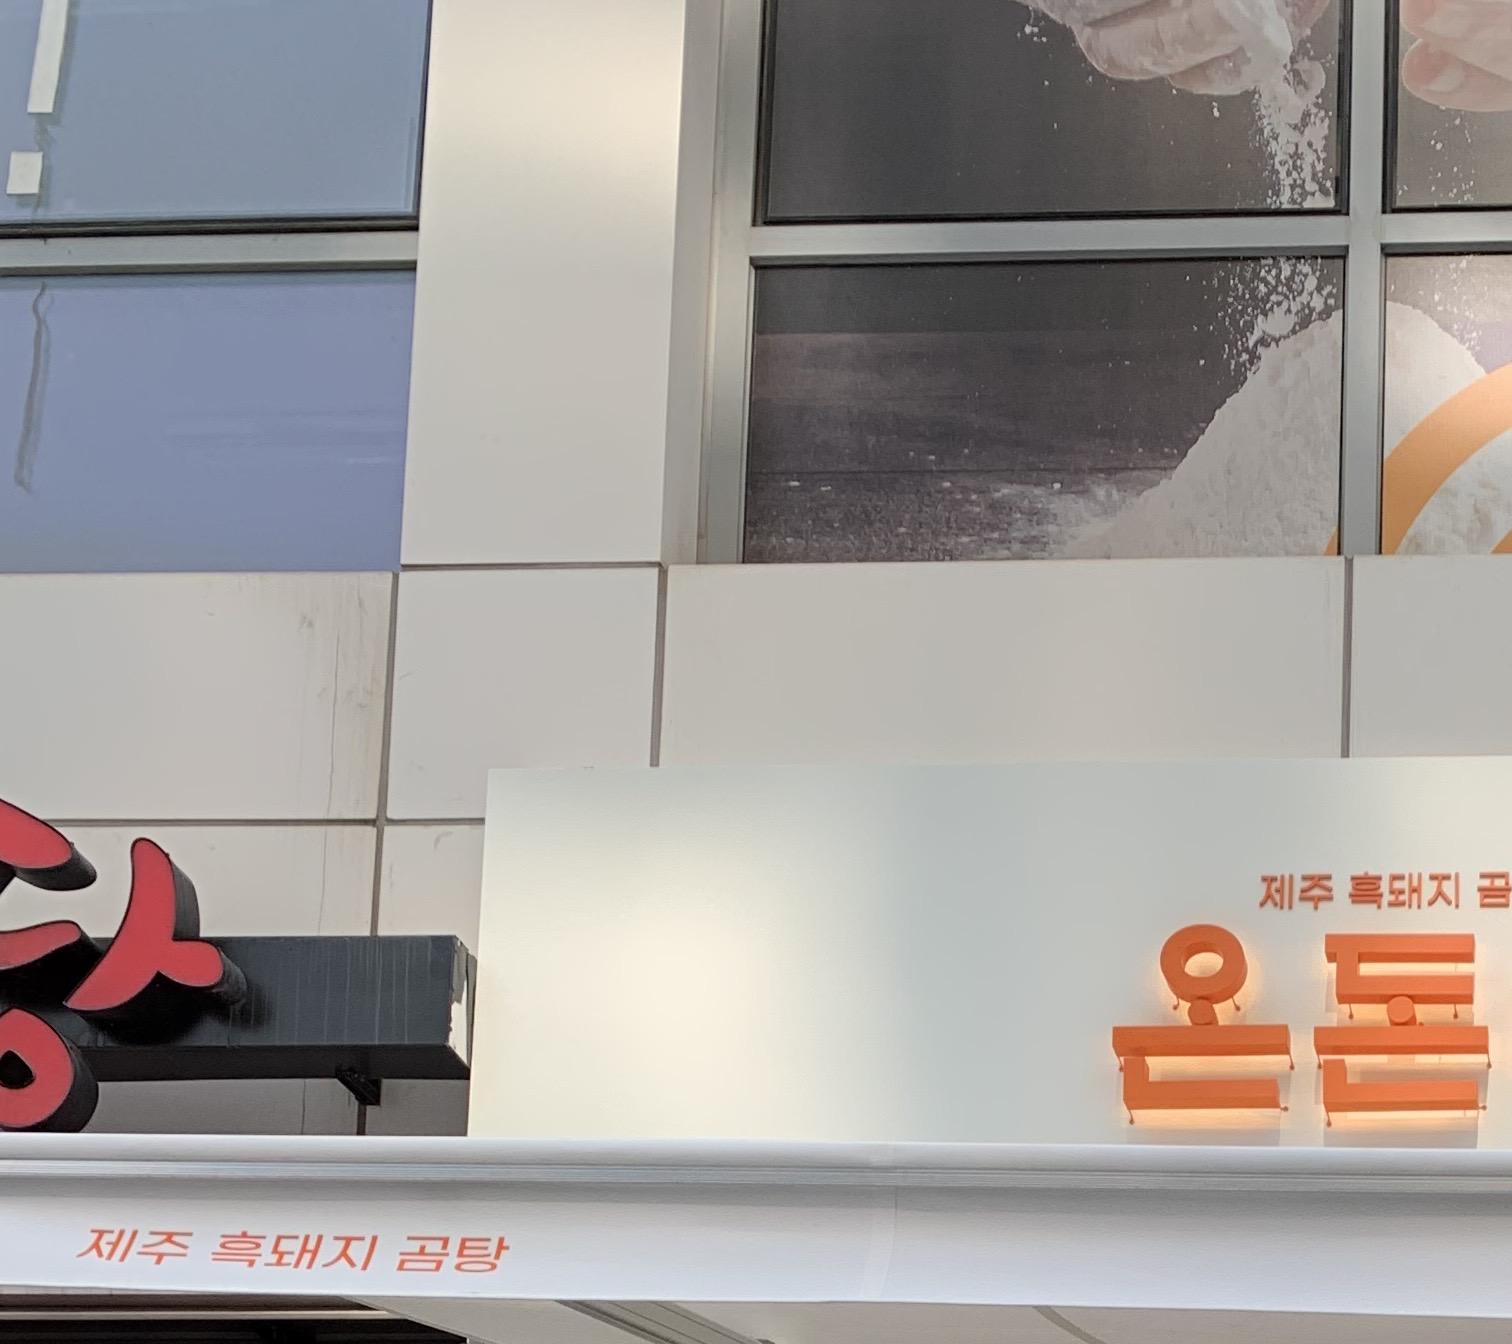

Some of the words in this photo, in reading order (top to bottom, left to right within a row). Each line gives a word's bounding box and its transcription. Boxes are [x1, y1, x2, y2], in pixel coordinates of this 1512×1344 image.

[1259, 871, 1334, 911] 제주
[1348, 871, 1462, 910] 흑돼지
[76, 1228, 194, 1265] 제주
[210, 1230, 378, 1271] 흑돼지
[395, 1234, 511, 1273] 곰탕
